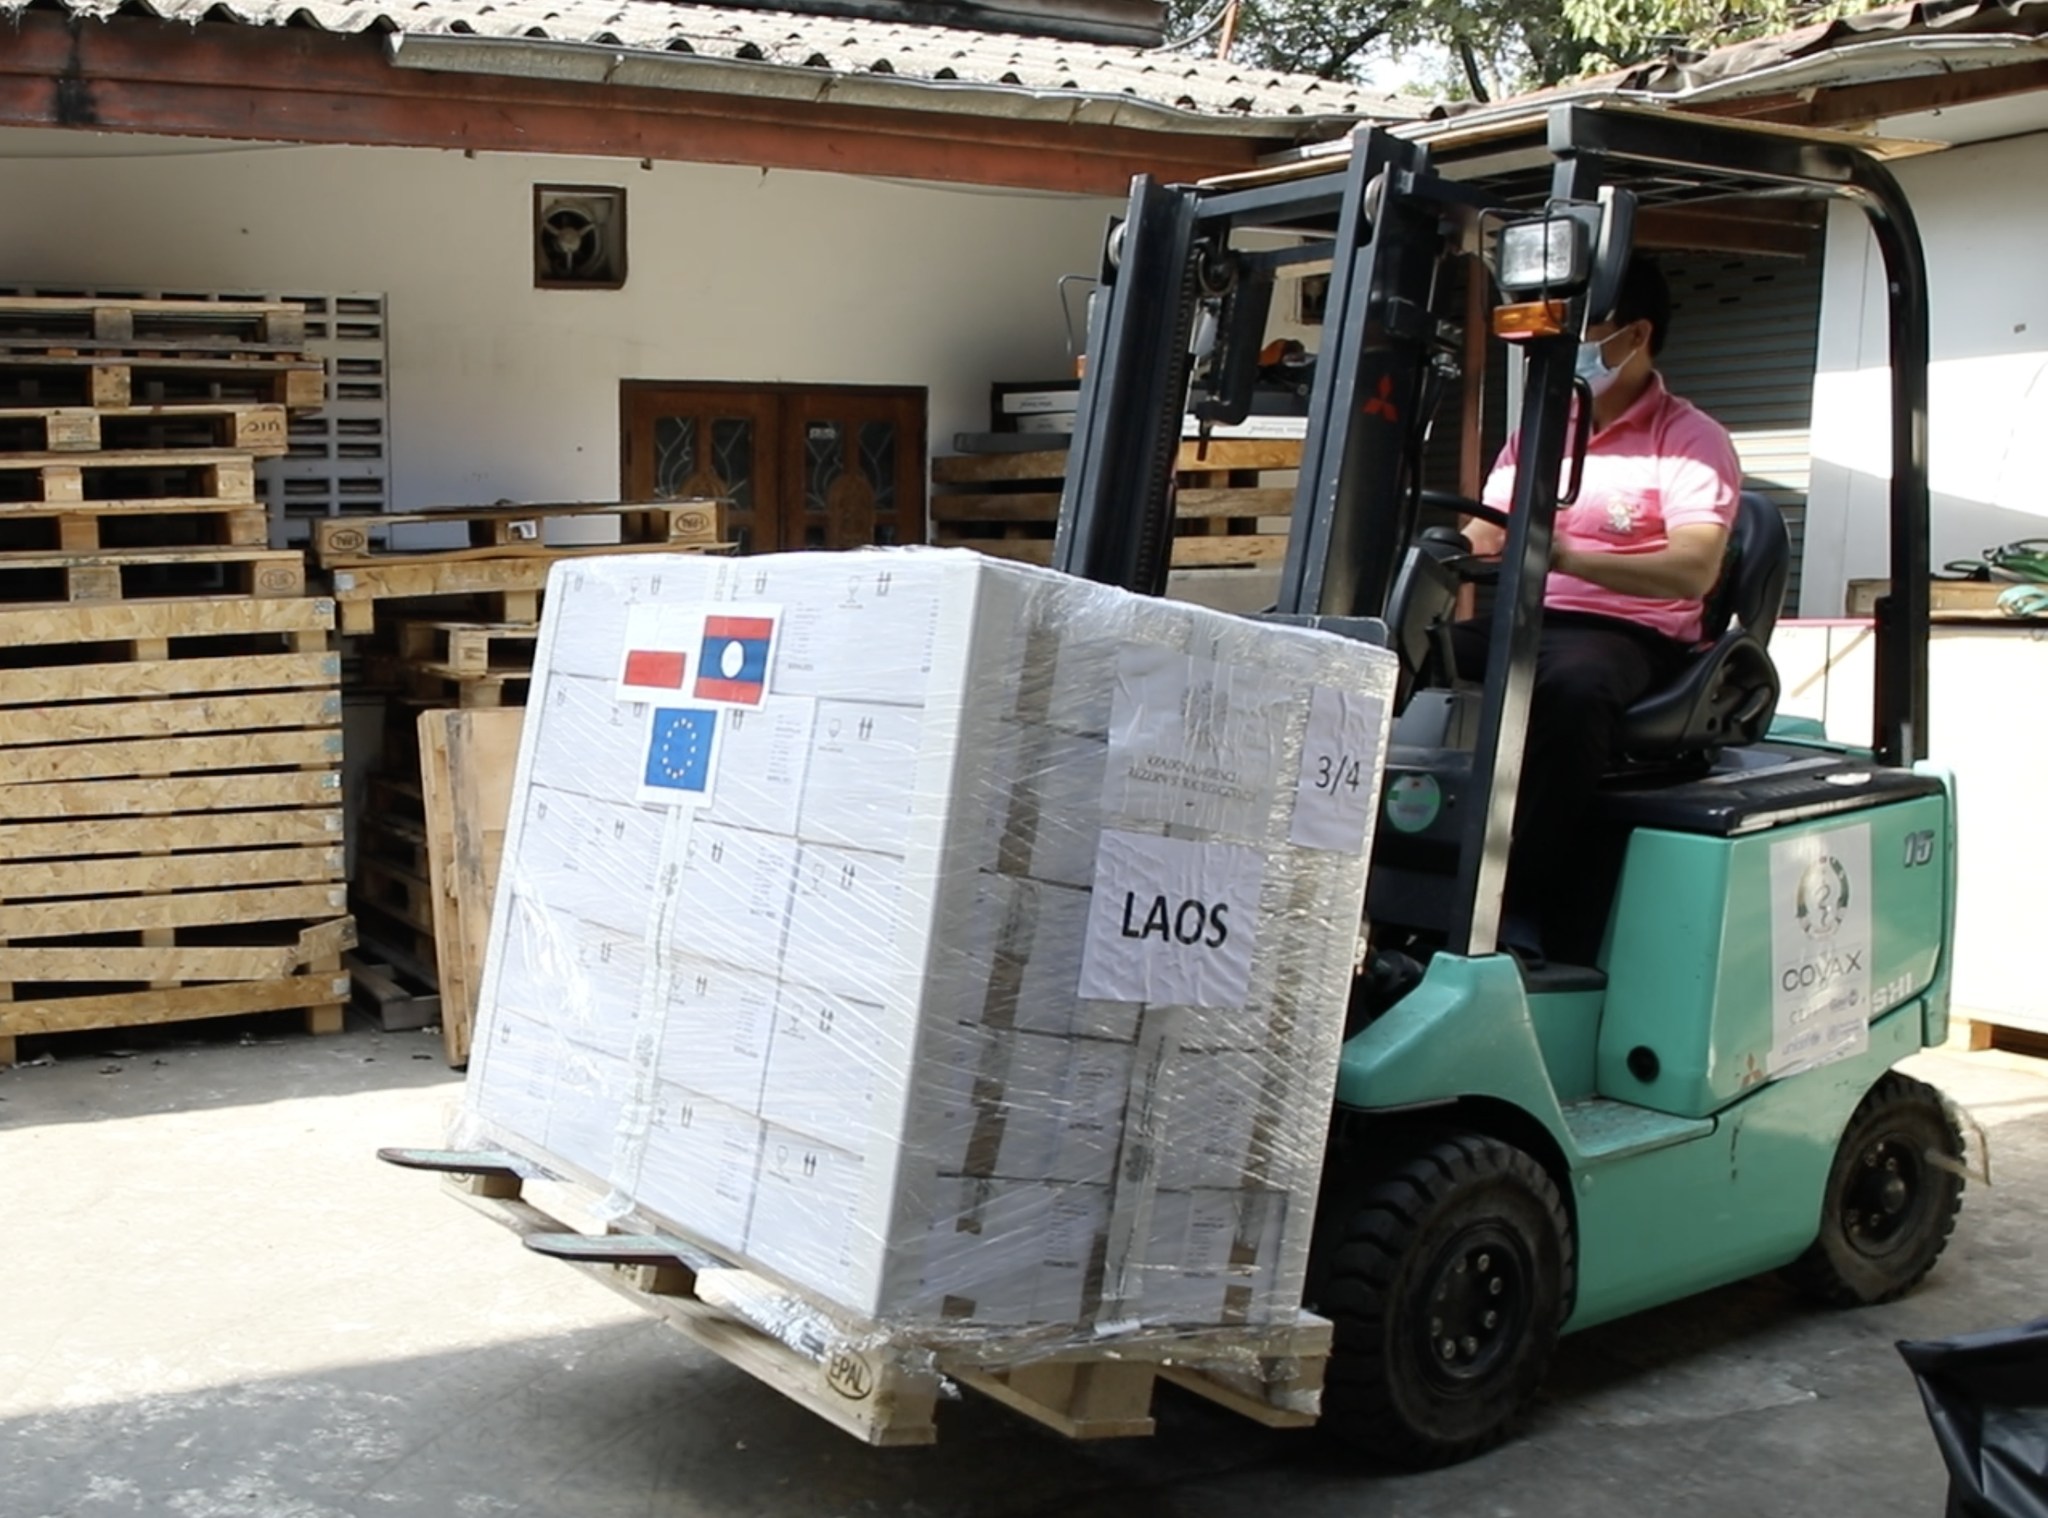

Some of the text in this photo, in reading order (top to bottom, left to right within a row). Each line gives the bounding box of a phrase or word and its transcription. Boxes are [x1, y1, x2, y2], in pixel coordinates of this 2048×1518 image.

[1315, 755, 1360, 796] 3/4
[1904, 830, 1935, 868] 15
[1121, 891, 1229, 949] LAOS
[1782, 950, 1862, 992] COVAX
[829, 1351, 864, 1395] EPAL
